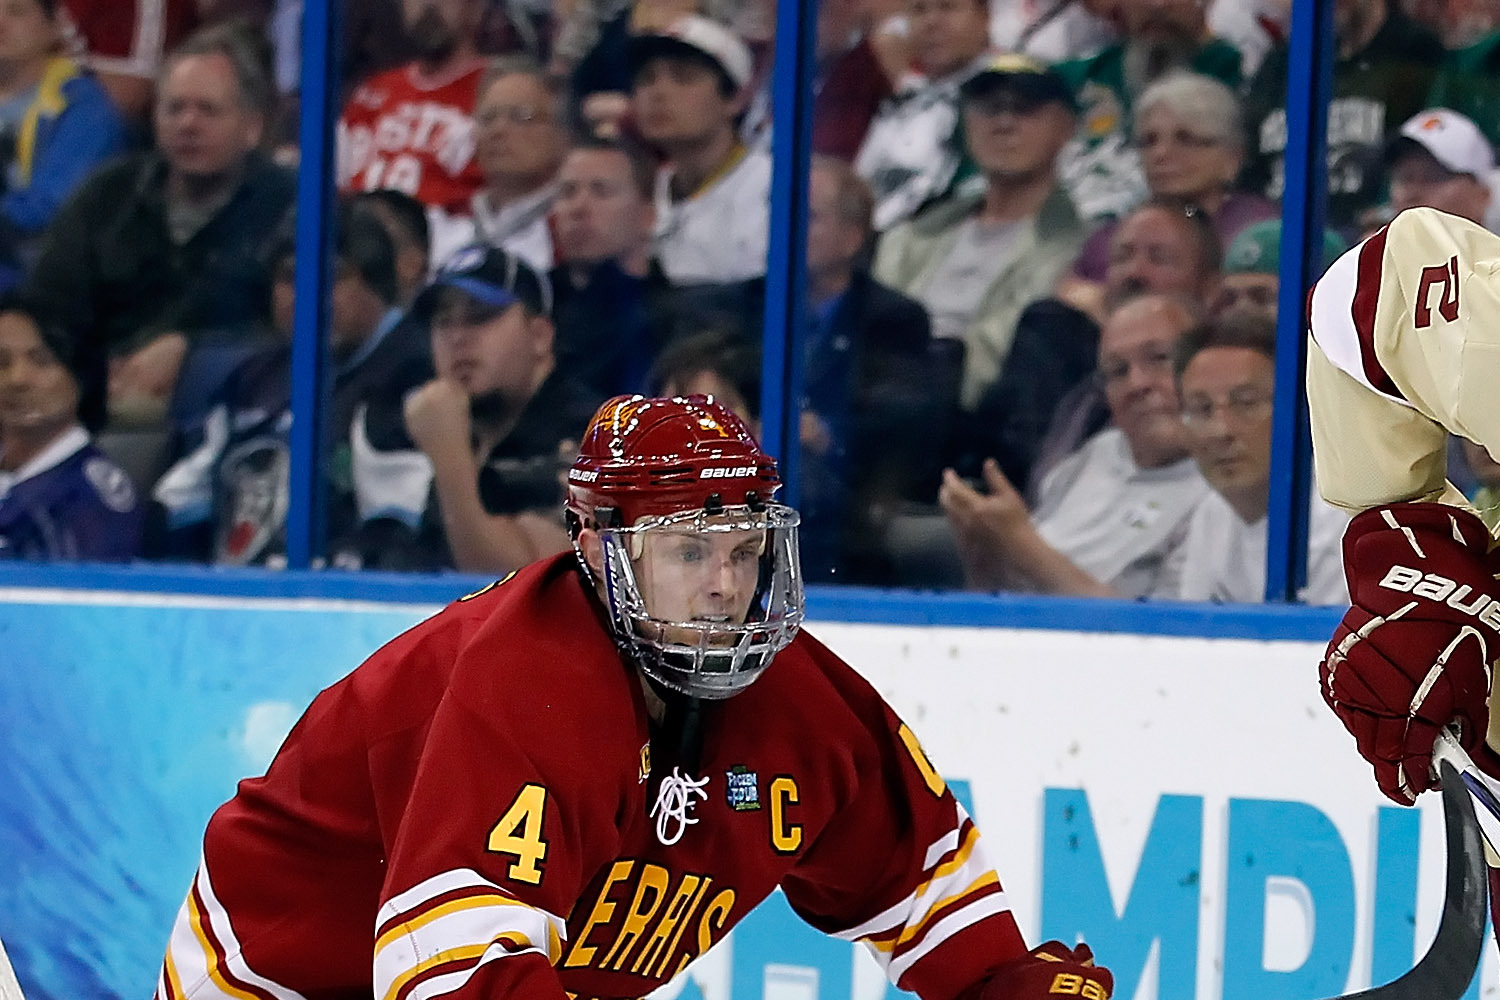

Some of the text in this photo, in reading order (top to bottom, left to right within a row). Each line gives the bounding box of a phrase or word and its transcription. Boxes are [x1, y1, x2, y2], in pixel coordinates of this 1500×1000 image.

[1414, 254, 1460, 329] 2
[700, 466, 758, 480] BAUER
[488, 784, 547, 885] 4
[770, 777, 802, 852] C
[565, 860, 736, 979] ERRIS
